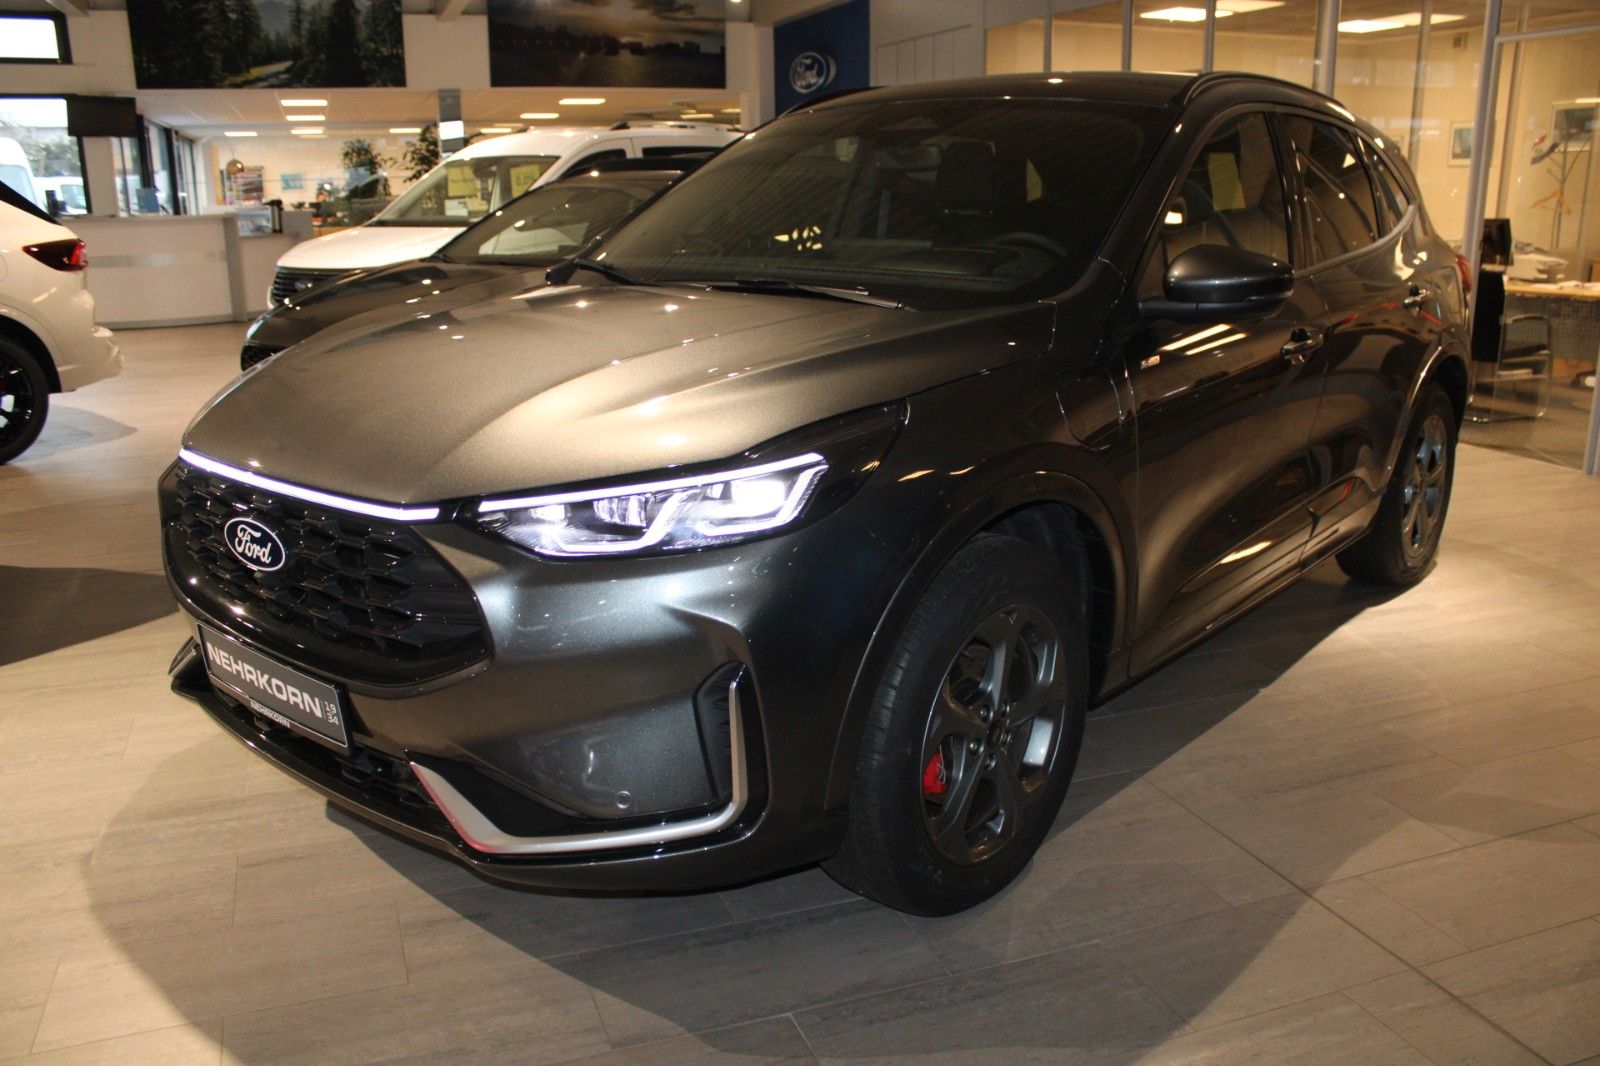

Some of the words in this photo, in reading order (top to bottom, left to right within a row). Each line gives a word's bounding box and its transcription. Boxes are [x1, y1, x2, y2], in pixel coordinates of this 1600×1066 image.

[795, 58, 819, 86] Ford
[235, 524, 272, 564] Ford
[206, 642, 323, 719] NEHRKORN
[250, 700, 290, 729] NEHRKORN
[324, 701, 337, 714] 19
[326, 712, 339, 726] 34
